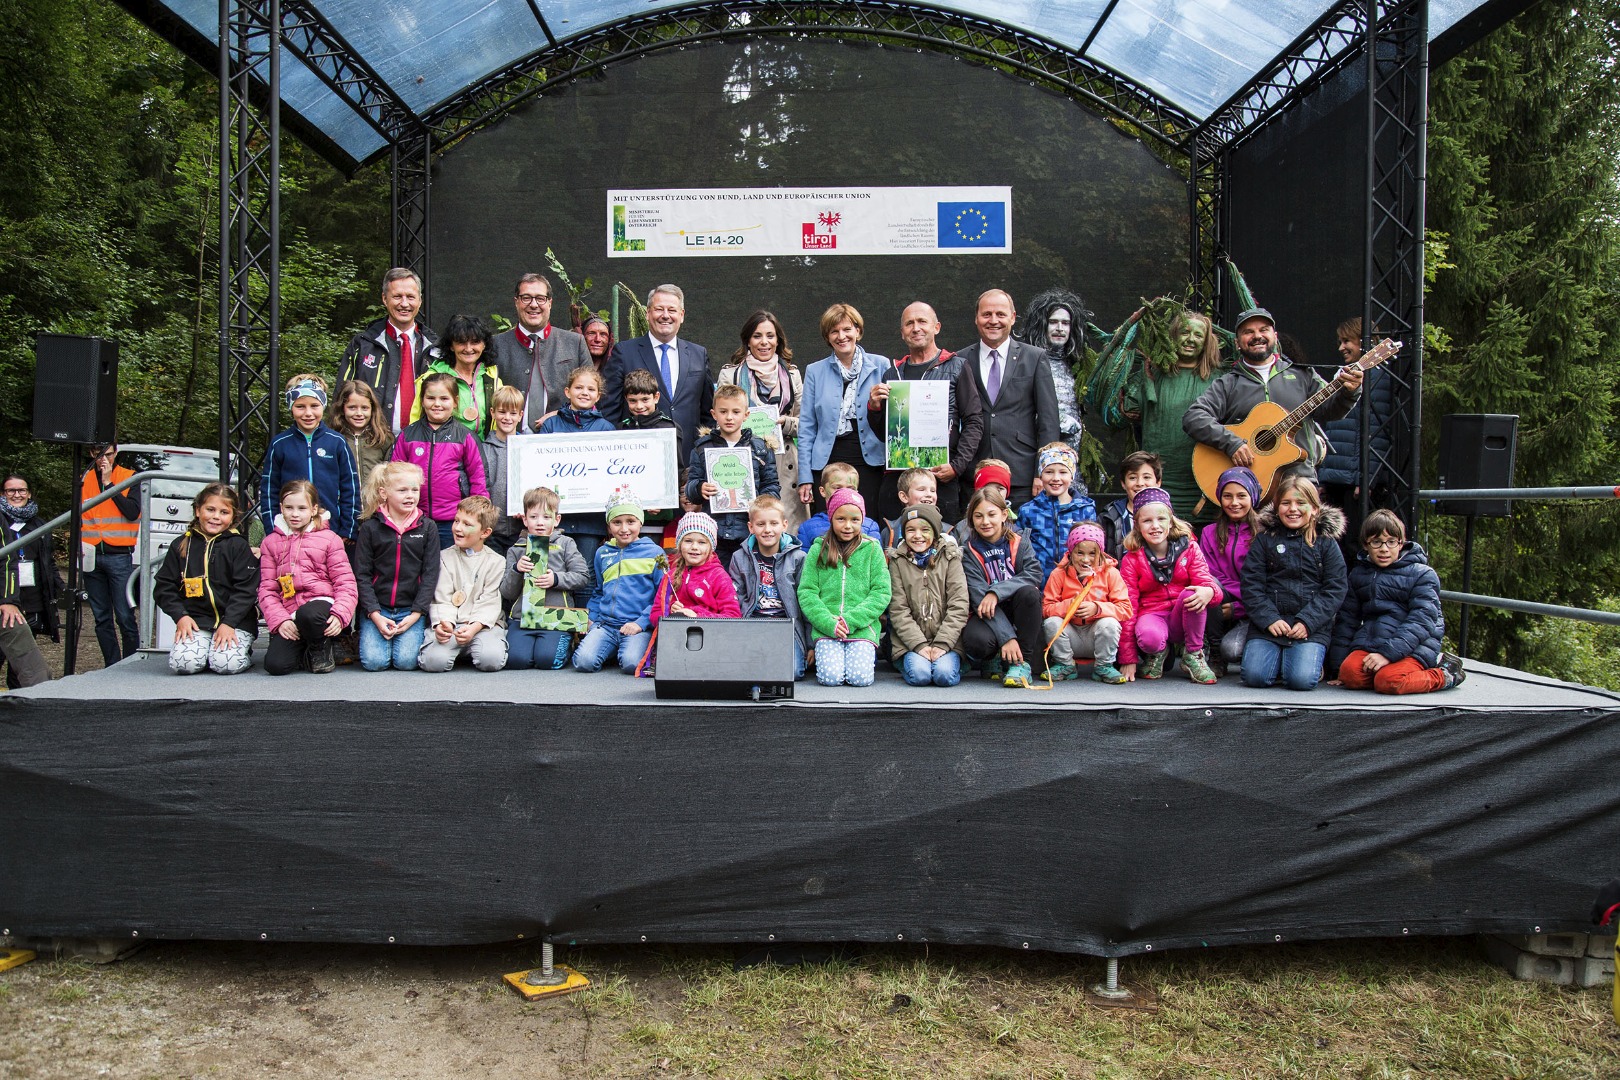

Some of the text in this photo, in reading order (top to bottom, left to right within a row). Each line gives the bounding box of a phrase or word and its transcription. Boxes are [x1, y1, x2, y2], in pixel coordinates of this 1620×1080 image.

[630, 193, 697, 201] UNTERSTÜTZUNG
[717, 194, 741, 202] BUND,
[784, 192, 844, 200] EUROPÄISCHER
[686, 235, 705, 246] LE
[803, 234, 832, 244] tirol
[534, 445, 596, 455] AUSZEICHNUNG
[606, 458, 646, 475] Euro
